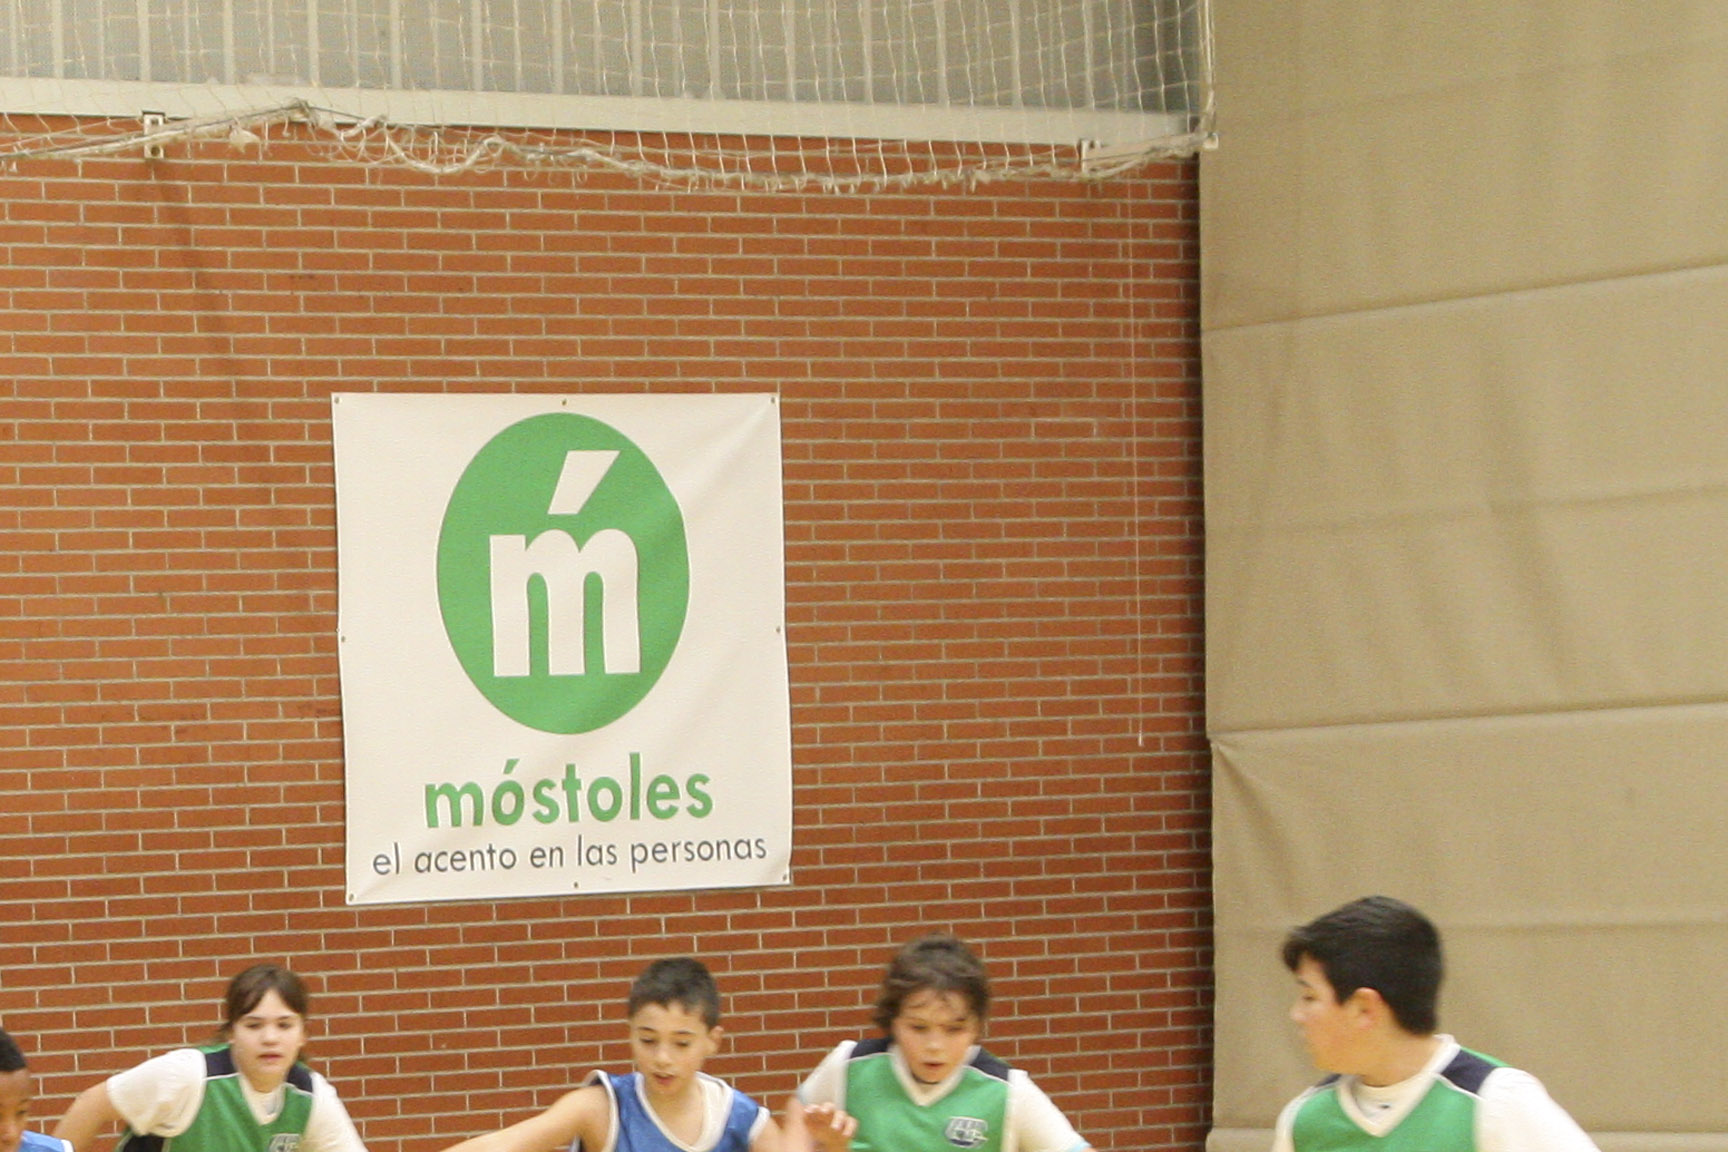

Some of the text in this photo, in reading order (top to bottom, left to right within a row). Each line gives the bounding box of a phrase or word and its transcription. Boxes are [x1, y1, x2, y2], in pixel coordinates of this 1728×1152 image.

[424, 752, 714, 829] móstoles
[372, 833, 768, 875] el acento en las personas
